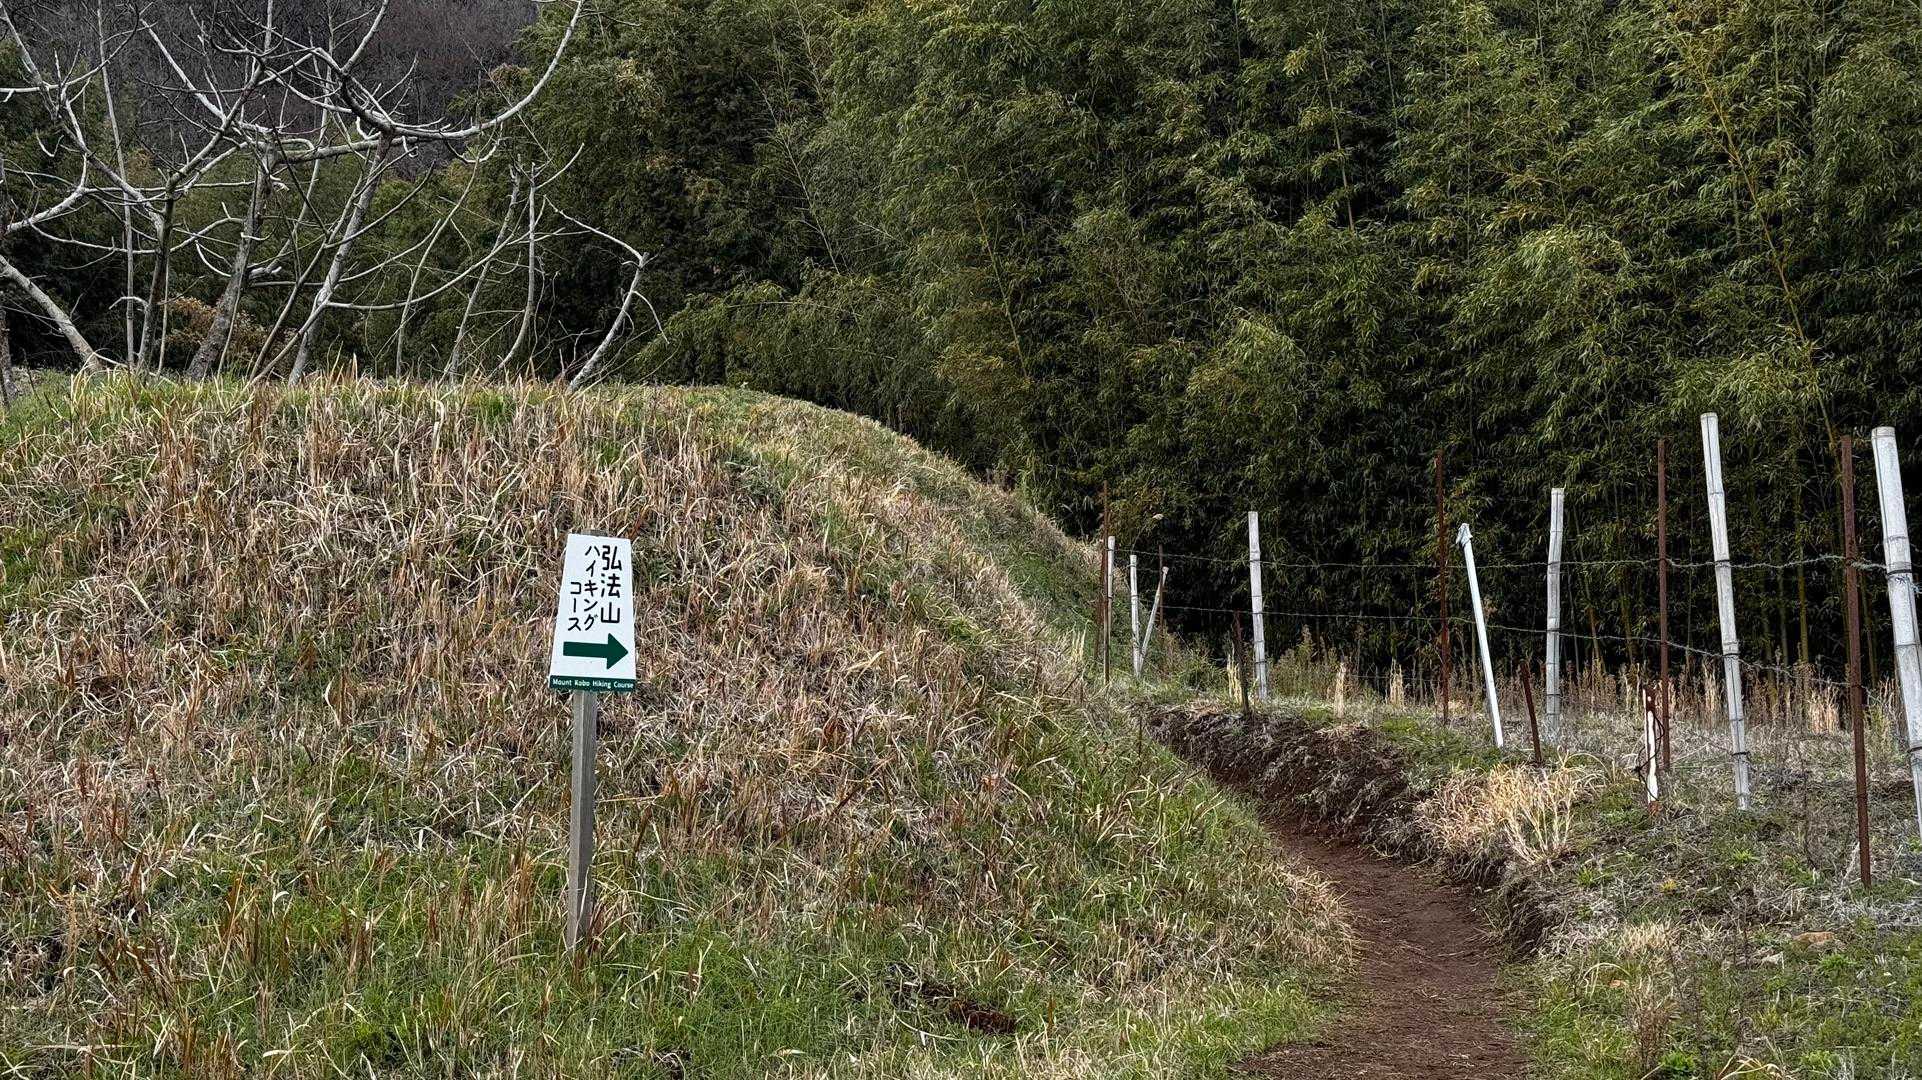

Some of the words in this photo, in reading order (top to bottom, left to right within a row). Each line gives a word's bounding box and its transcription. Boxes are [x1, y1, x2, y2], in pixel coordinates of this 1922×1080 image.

[567, 581, 582, 631] コース
[584, 545, 601, 631] ハイキング
[600, 545, 622, 624] 弘法山
[552, 678, 572, 686] Mount
[574, 679, 590, 687] Kobo
[592, 680, 611, 689] Hiking
[613, 681, 634, 689] Course
